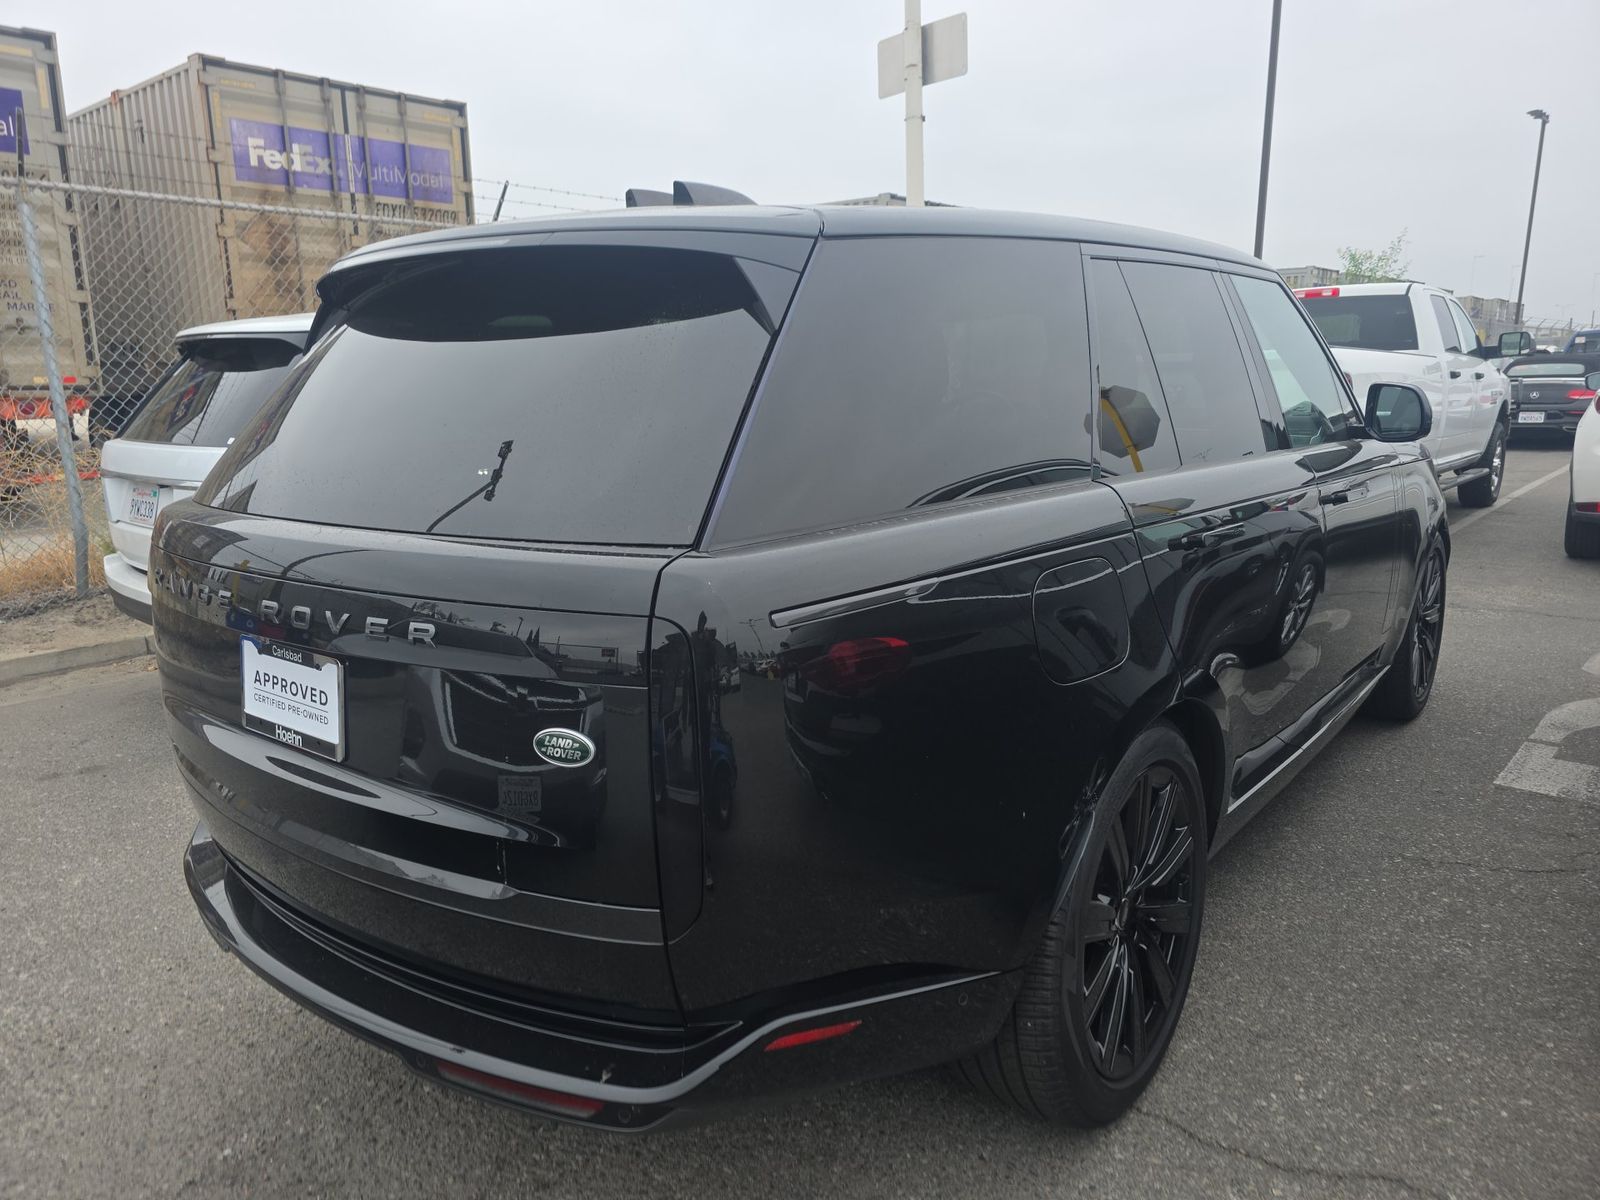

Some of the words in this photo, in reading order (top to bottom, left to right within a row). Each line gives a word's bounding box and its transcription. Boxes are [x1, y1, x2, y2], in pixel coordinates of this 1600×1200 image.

[0, 115, 14, 137] al
[247, 137, 334, 176] FedEx
[350, 161, 445, 190] MultiModal
[261, 599, 438, 648] ROVER
[271, 645, 302, 663] Carlsbad
[254, 670, 328, 706] APPROVED
[254, 693, 286, 710] CERTIFIED
[288, 705, 329, 725] PRE-OWNED
[275, 724, 303, 747] Hoehn
[544, 735, 572, 748] LAND
[546, 747, 581, 760] ROVER
